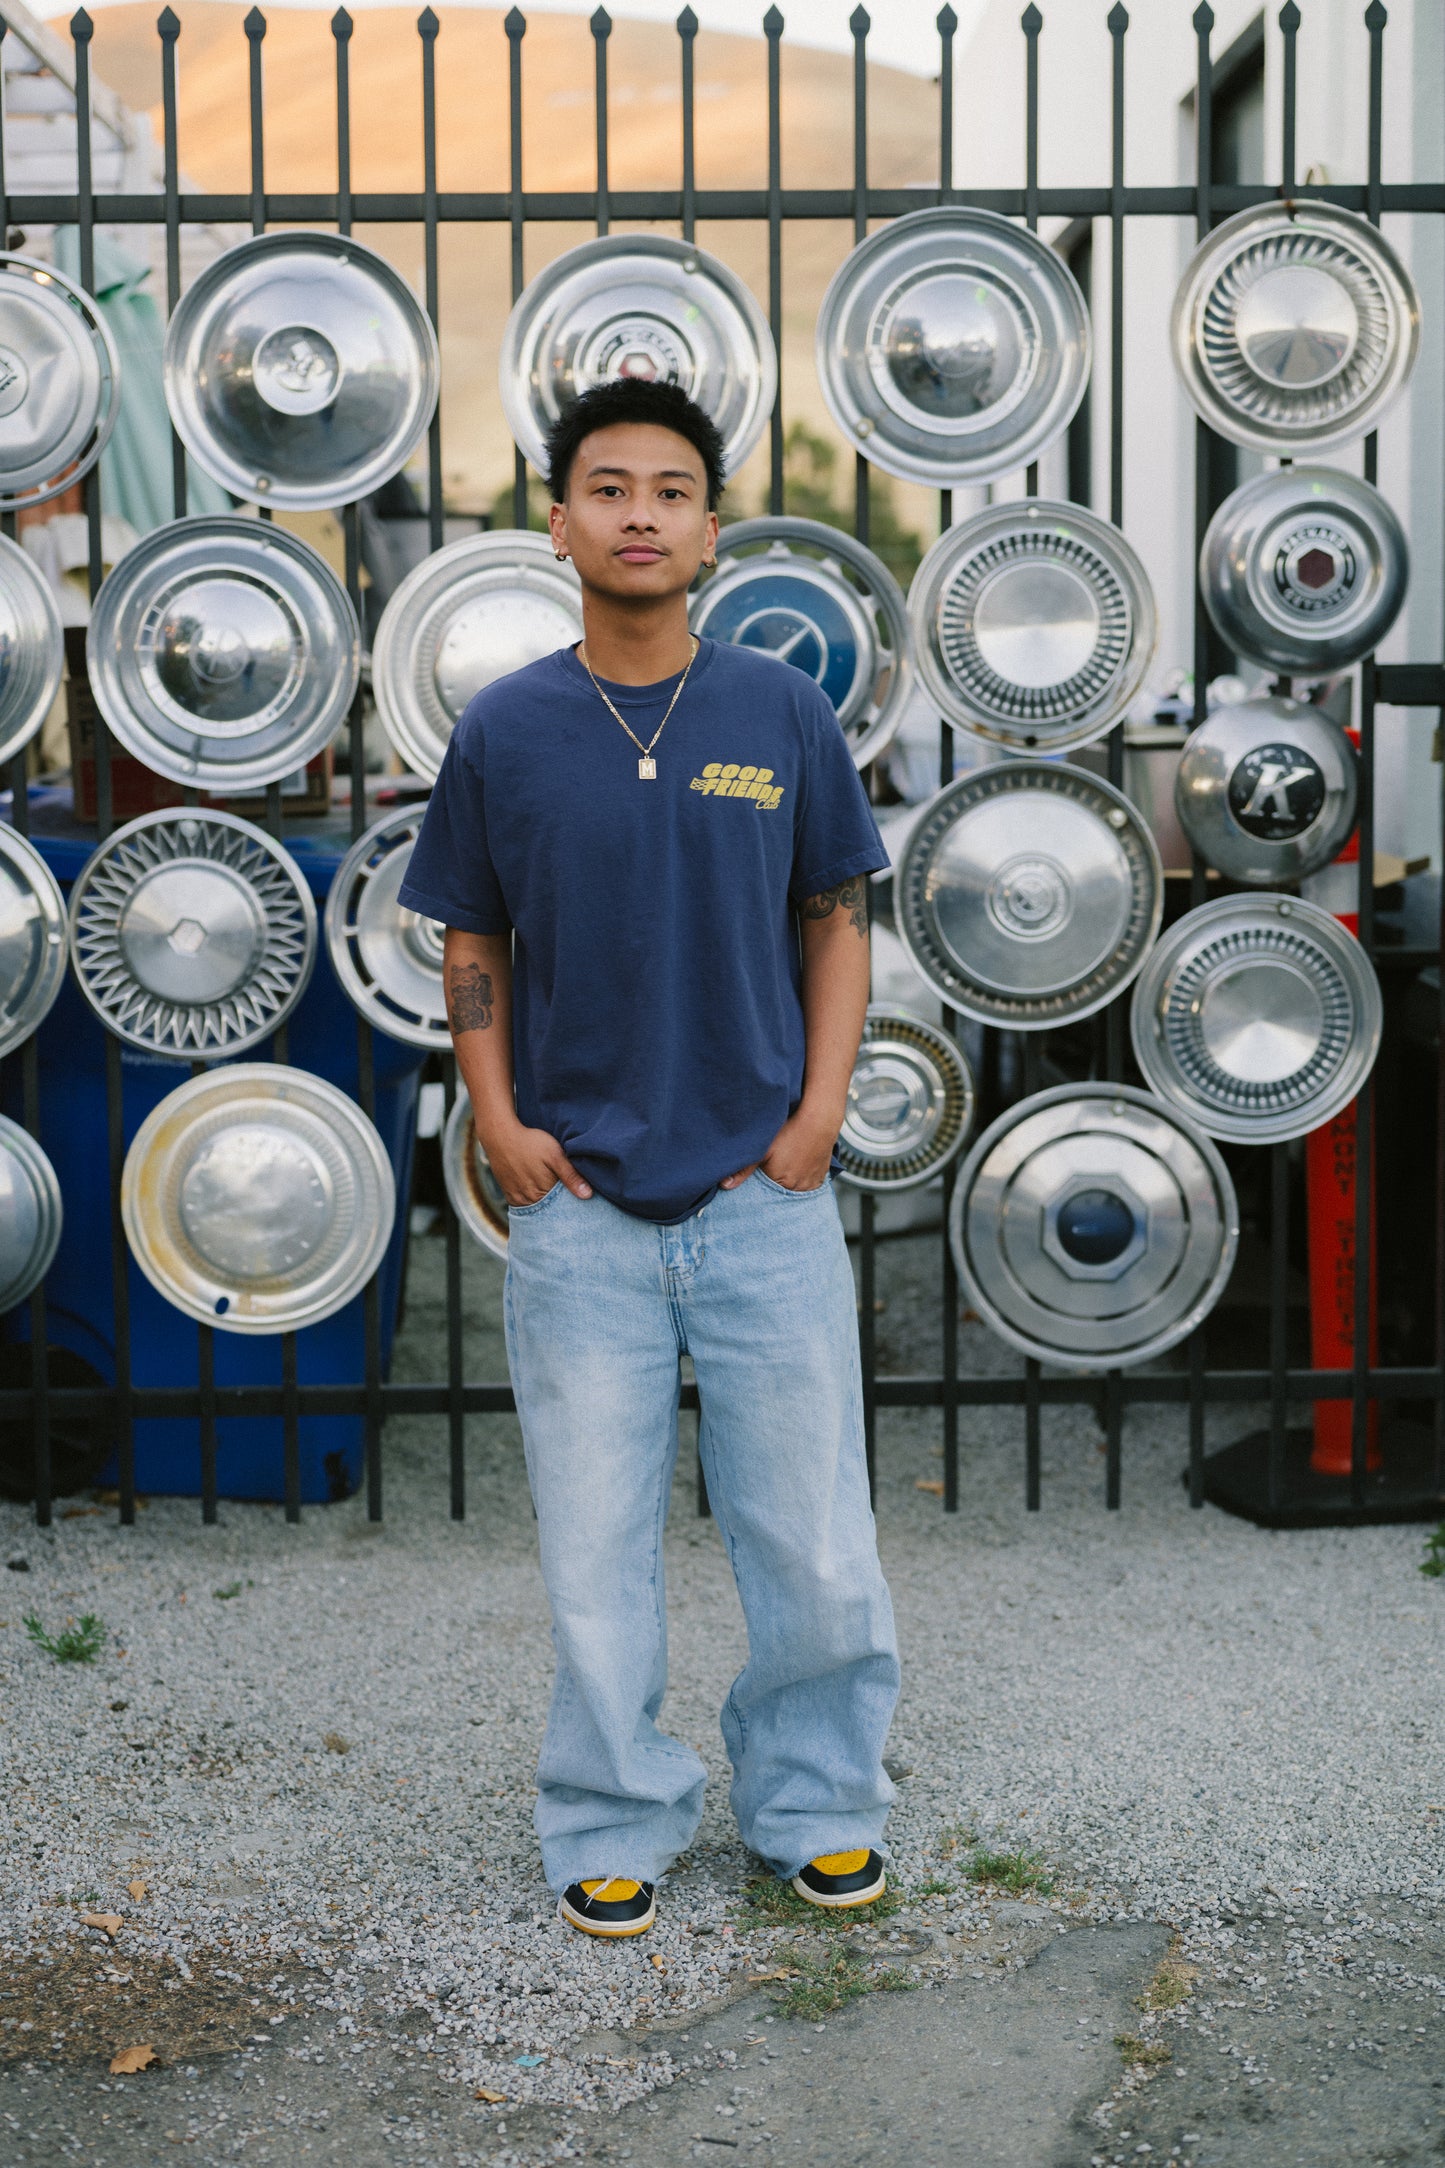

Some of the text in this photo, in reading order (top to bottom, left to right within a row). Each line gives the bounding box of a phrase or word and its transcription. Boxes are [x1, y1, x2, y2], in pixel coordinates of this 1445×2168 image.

[1280, 527, 1348, 554] PACKARD
[641, 761, 654, 777] M
[702, 762, 774, 783] GOOD
[702, 778, 785, 802] FRIENDS
[1240, 762, 1315, 820] K
